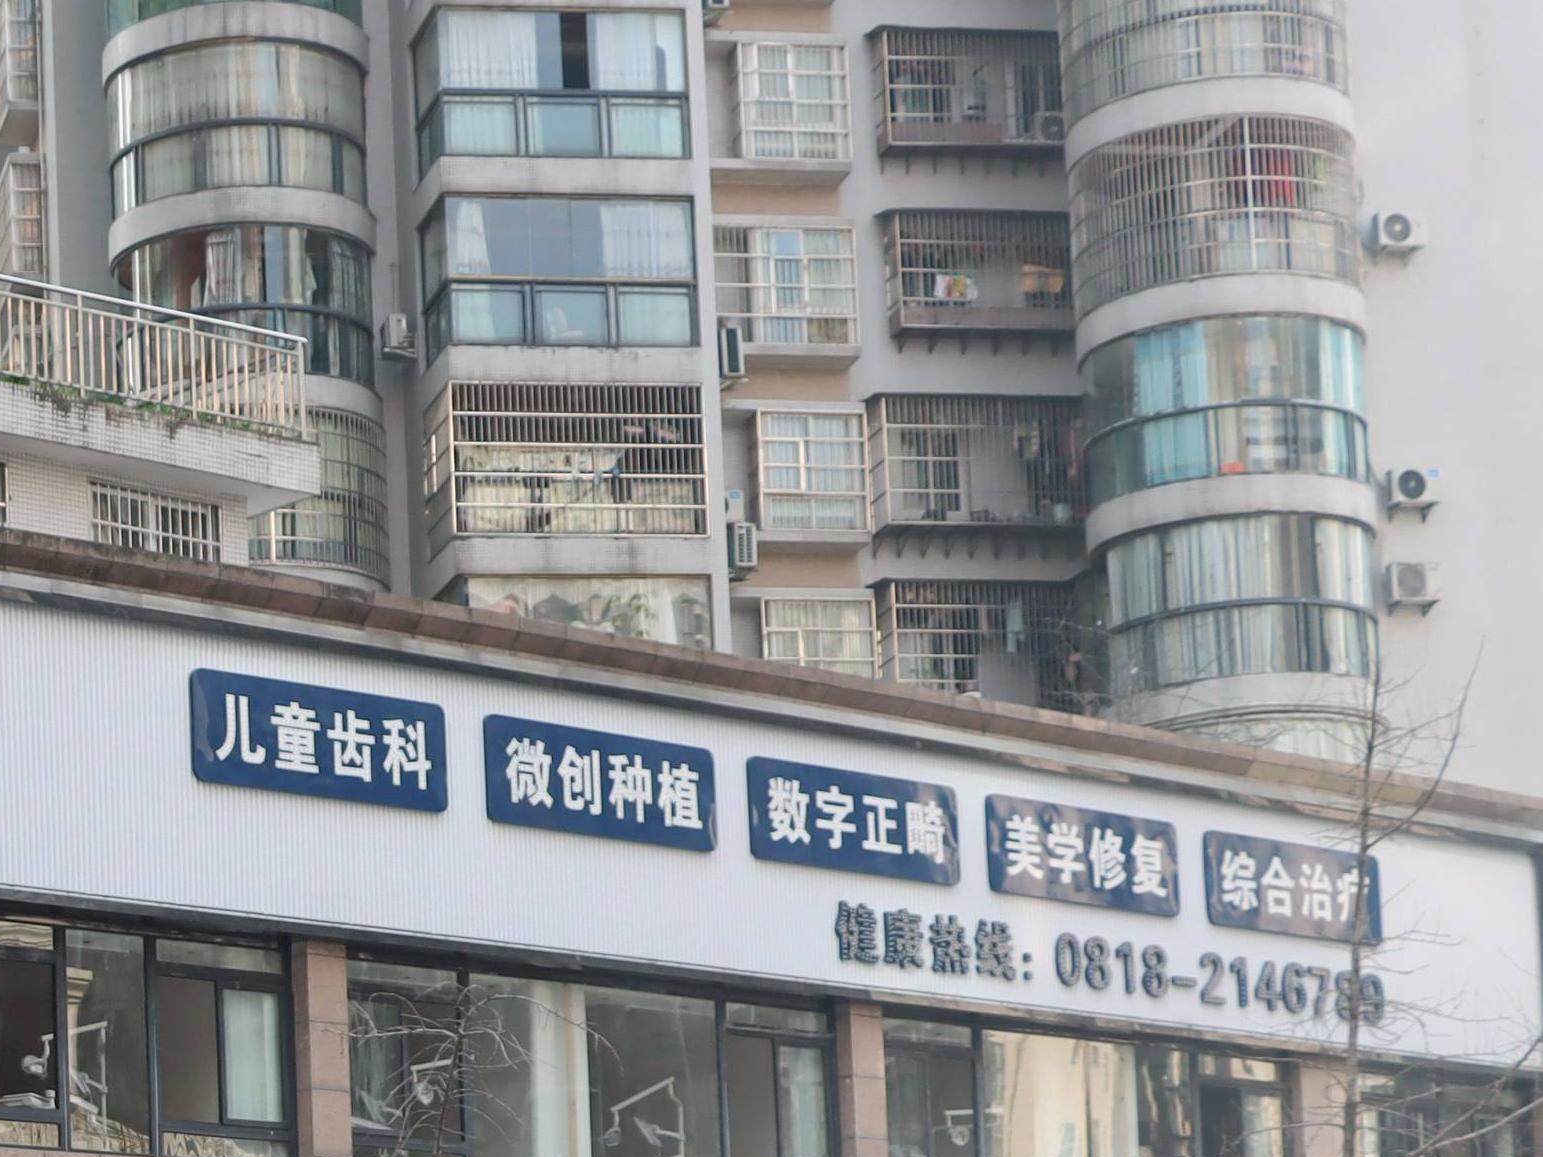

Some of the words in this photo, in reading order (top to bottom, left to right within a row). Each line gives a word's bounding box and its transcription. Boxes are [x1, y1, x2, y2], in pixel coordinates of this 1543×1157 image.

[215, 692, 433, 791] 儿童齿科
[504, 736, 704, 831] 微创种植
[767, 776, 947, 865] 数字正畸
[1004, 813, 1169, 899] 美学修复
